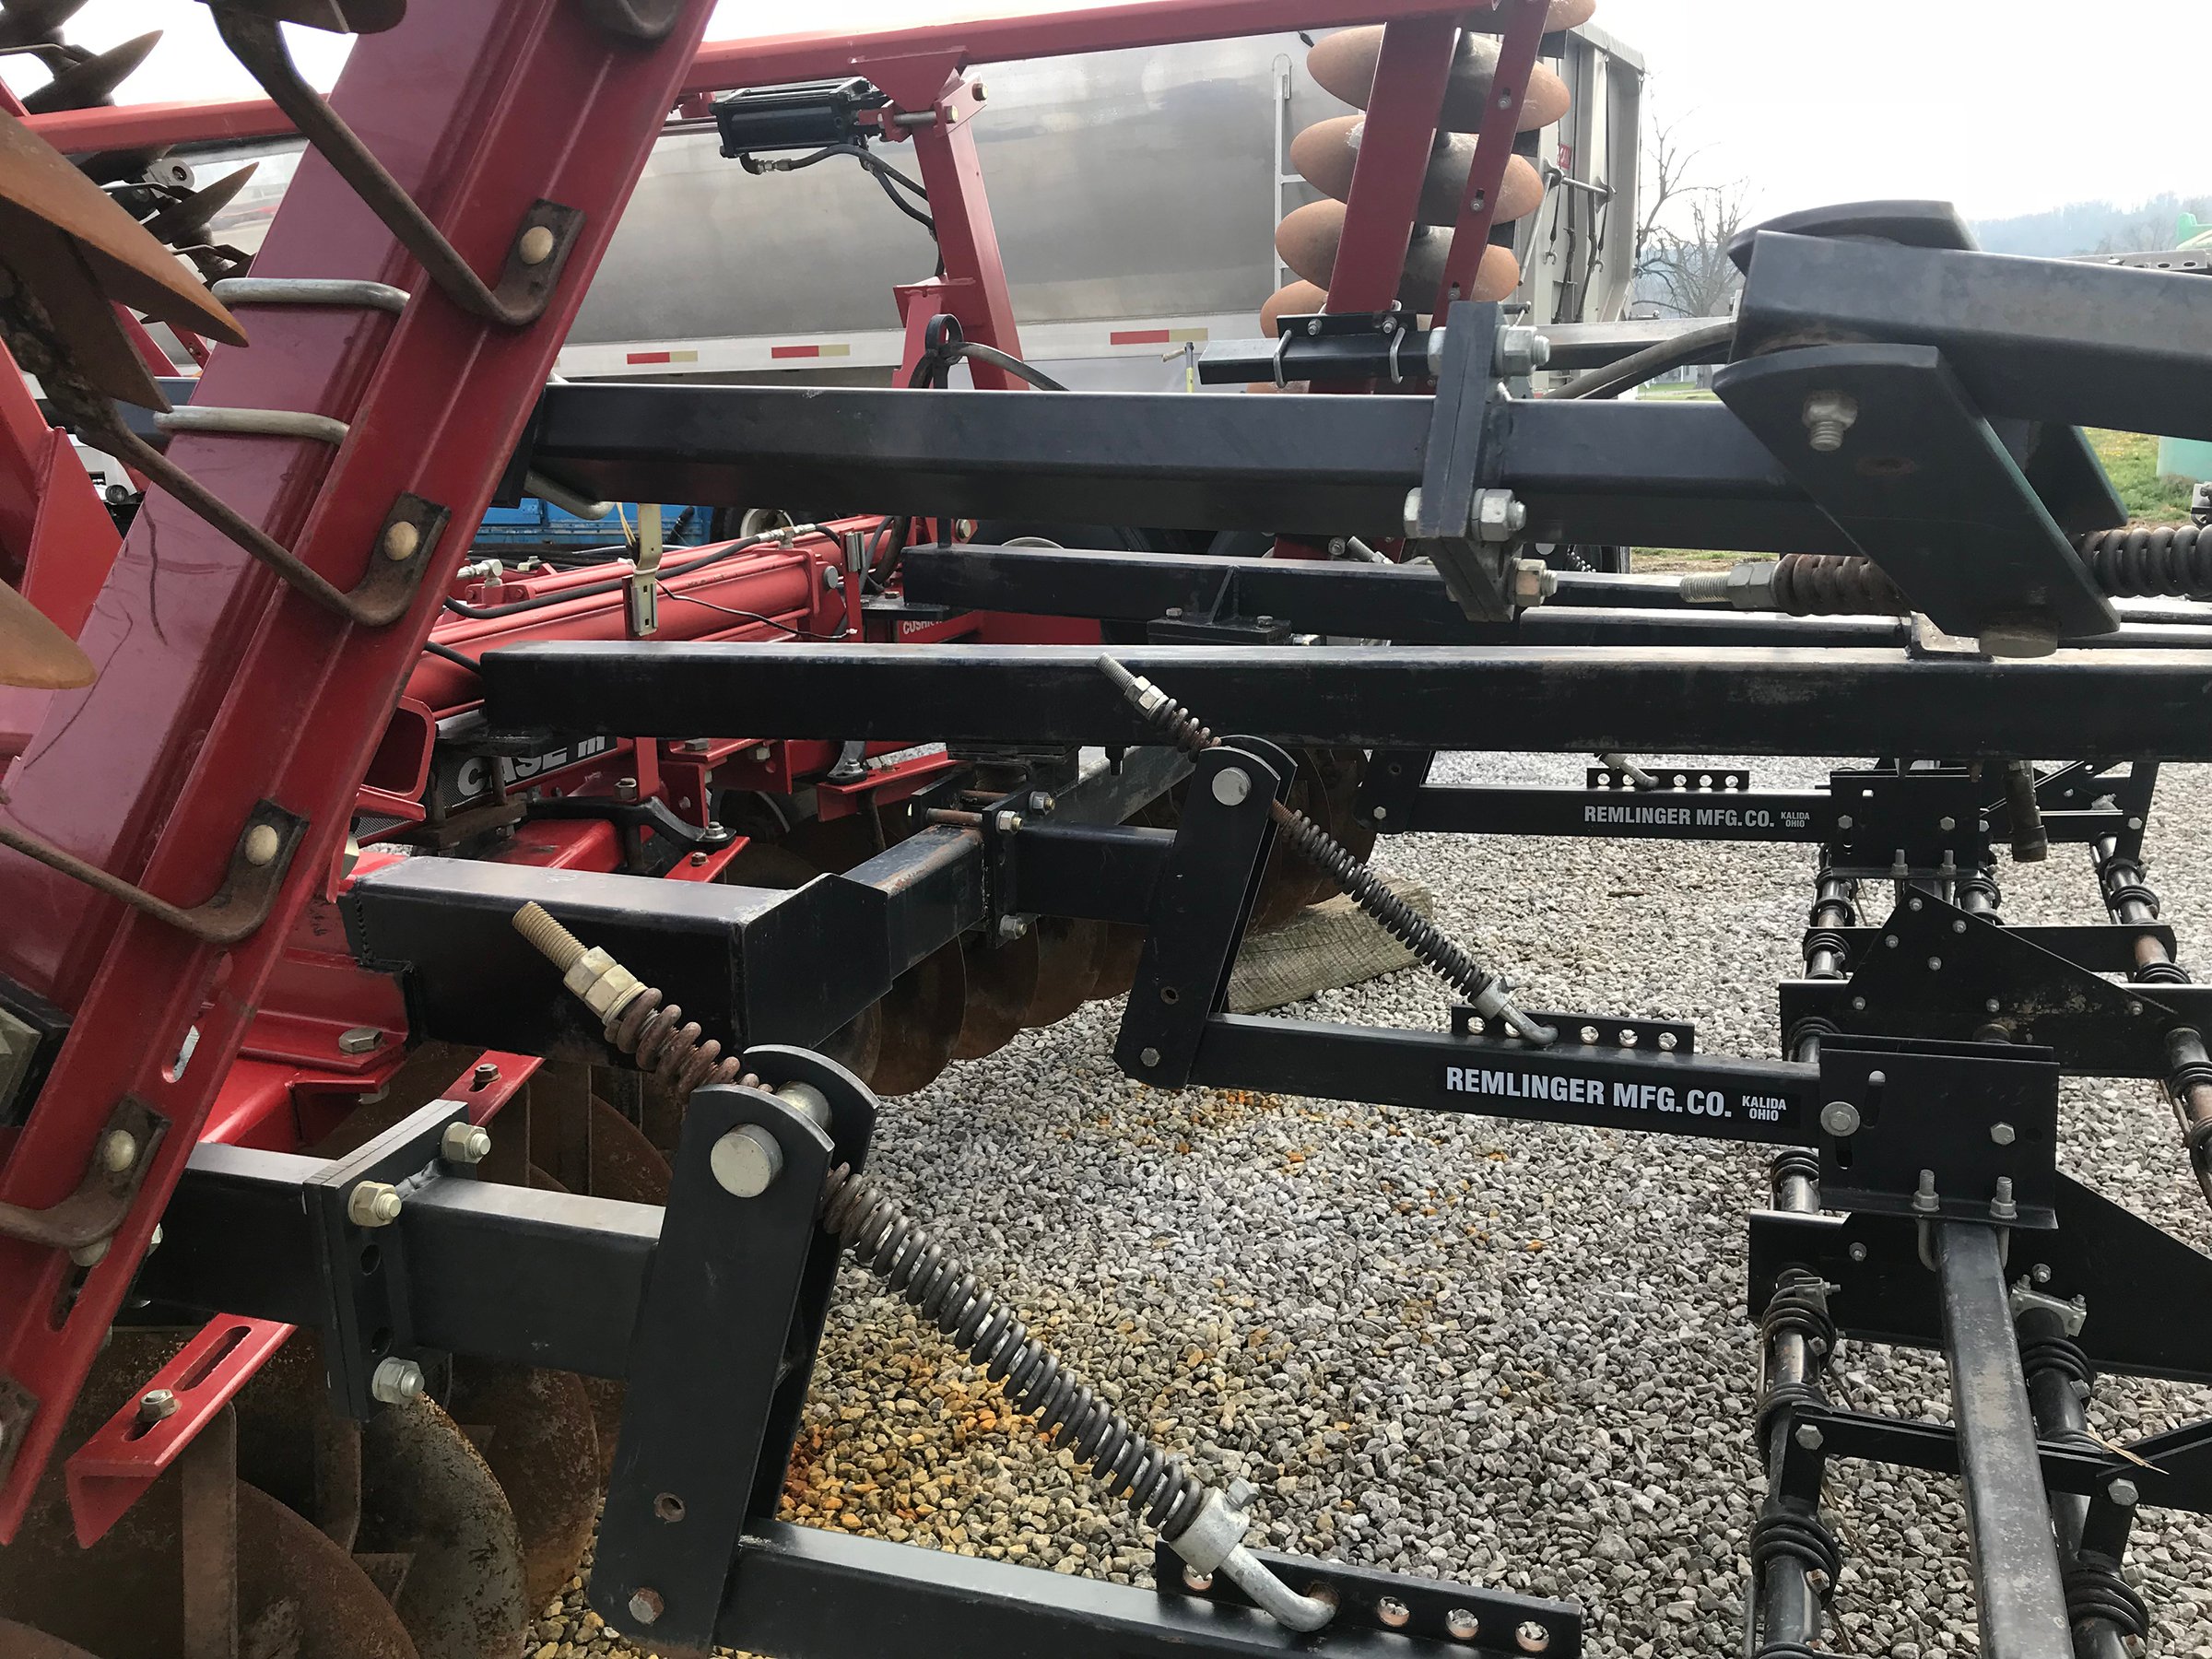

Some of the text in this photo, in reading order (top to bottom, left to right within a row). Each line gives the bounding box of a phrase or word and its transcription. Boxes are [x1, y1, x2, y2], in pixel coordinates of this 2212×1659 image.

[902, 620, 943, 635] CUSHI
[1584, 806, 1691, 825] REMLINGER
[1781, 811, 1810, 820] KALIDA
[1785, 818, 1806, 829] OHIO
[1446, 1066, 1605, 1105] REMLINGER
[1741, 1095, 1787, 1111] KALIDA
[1748, 1107, 1779, 1122] OHIO
